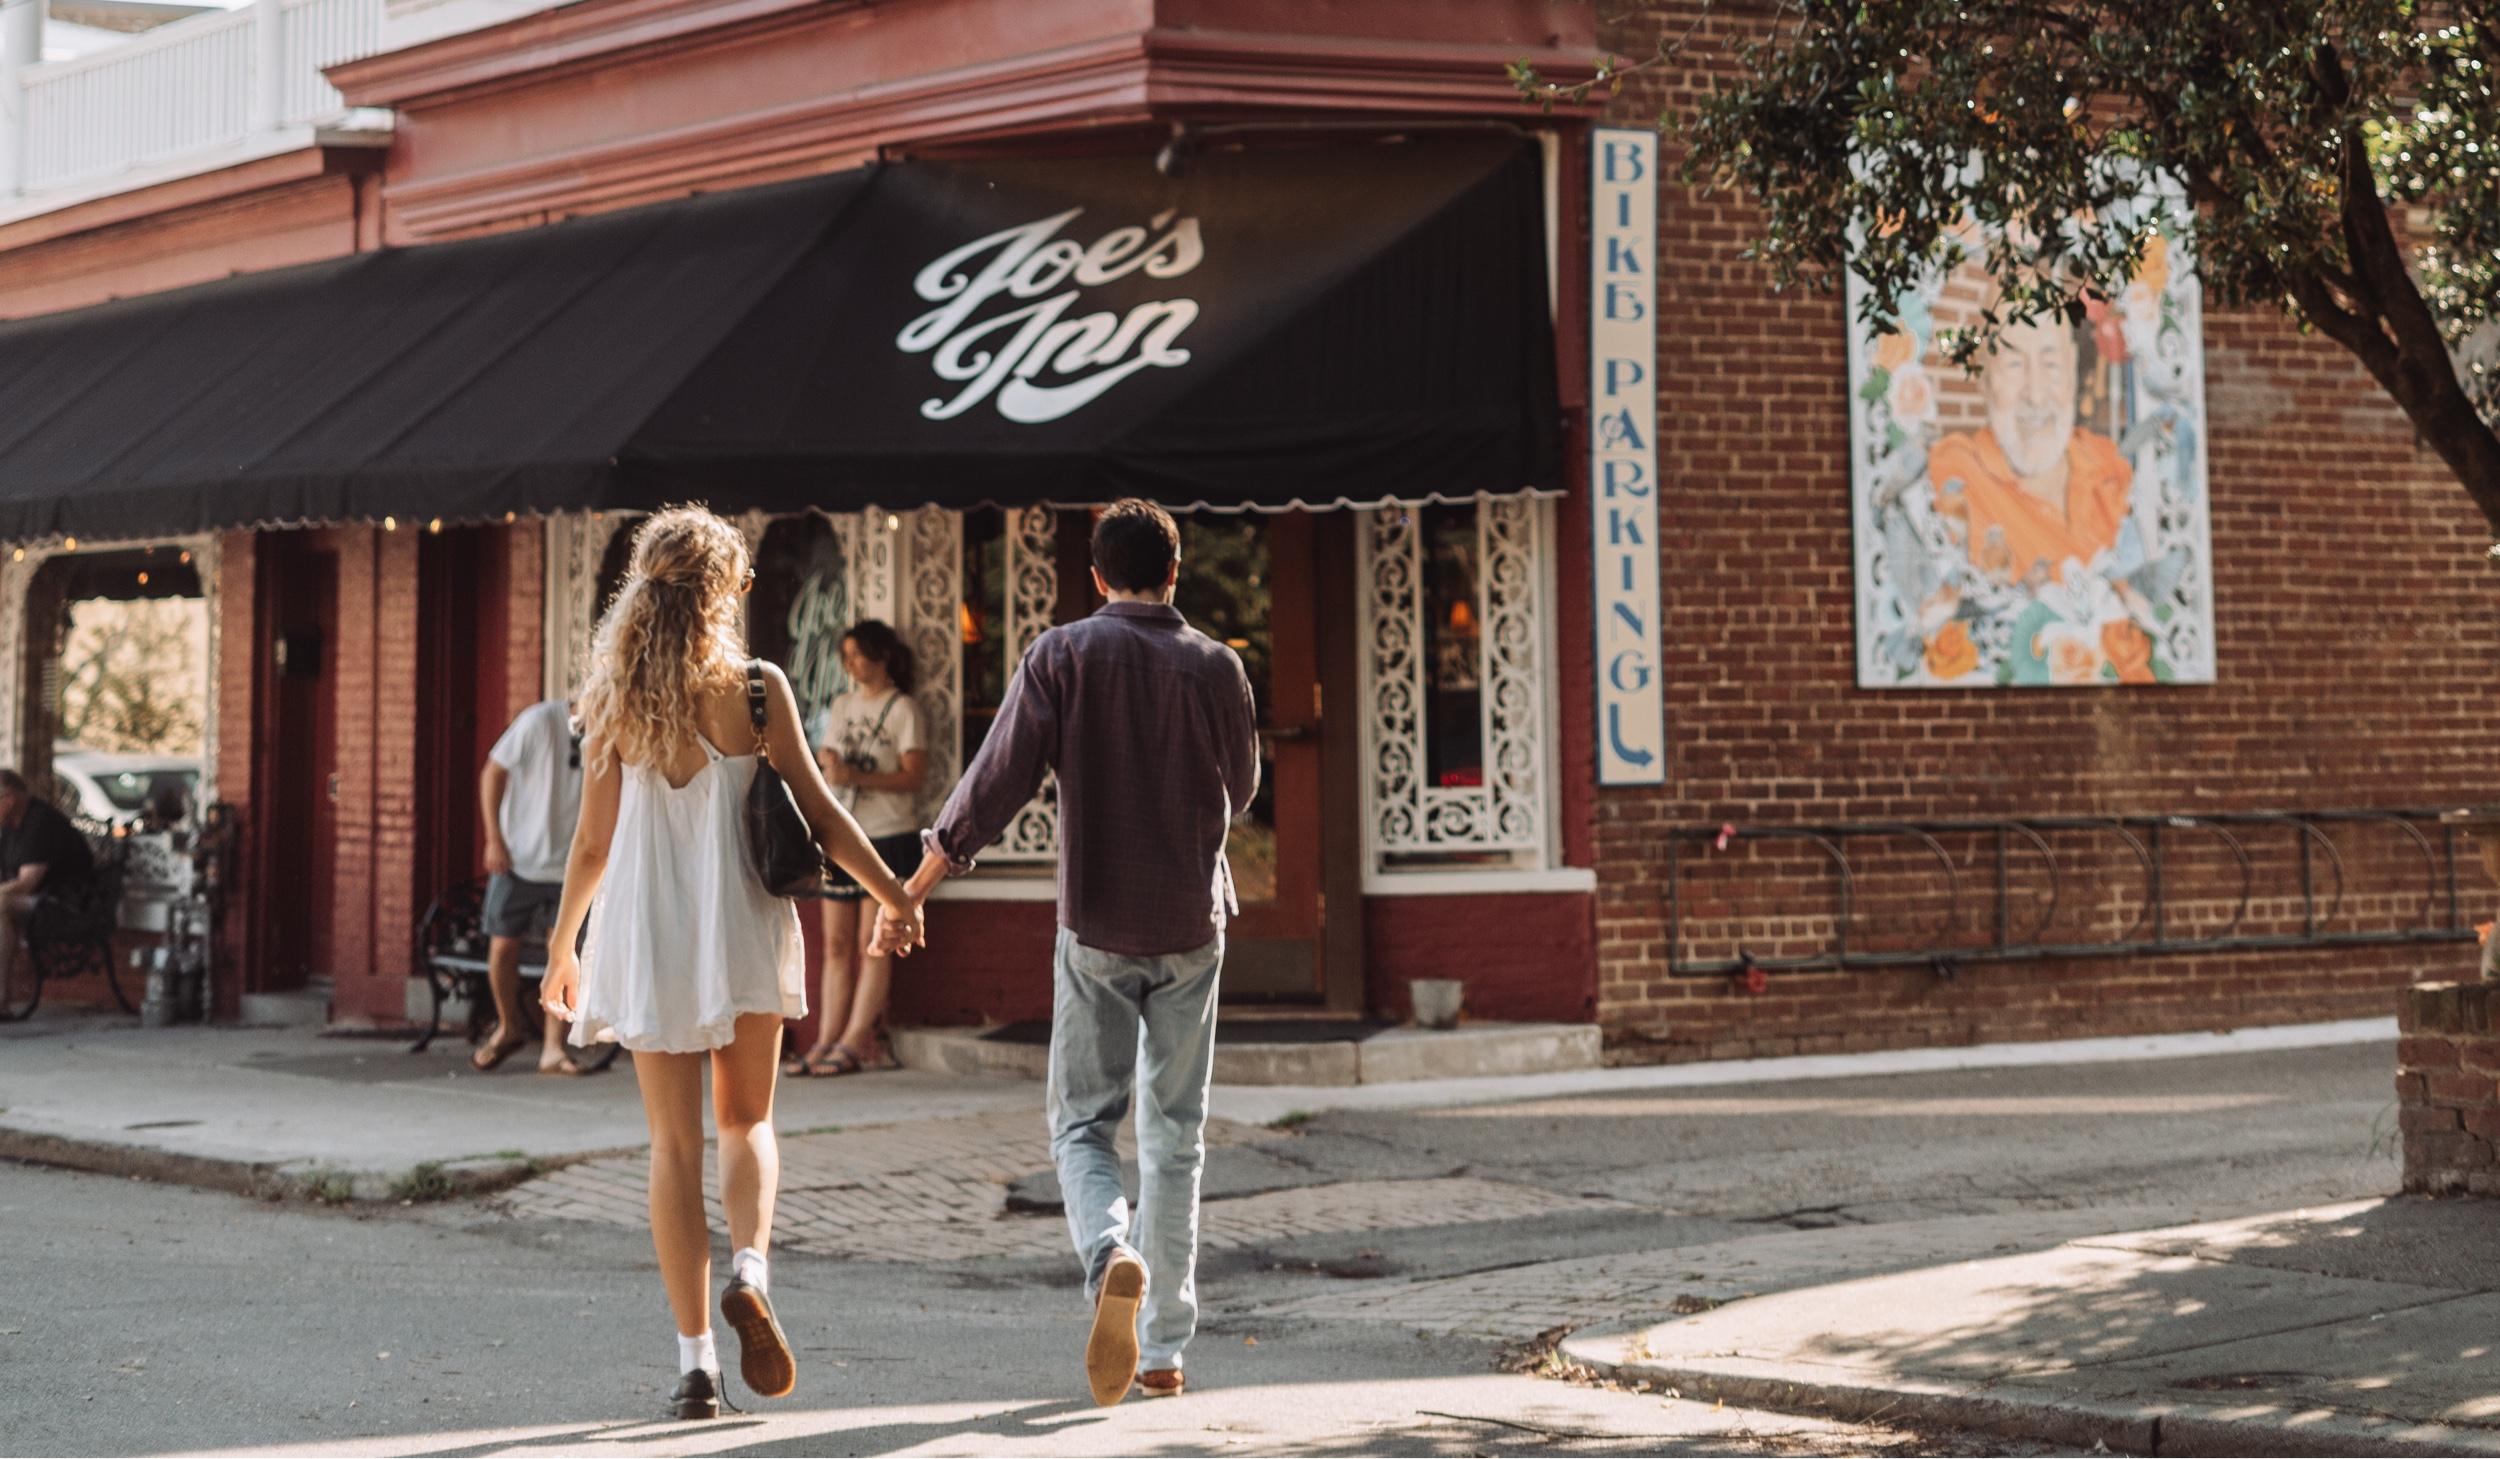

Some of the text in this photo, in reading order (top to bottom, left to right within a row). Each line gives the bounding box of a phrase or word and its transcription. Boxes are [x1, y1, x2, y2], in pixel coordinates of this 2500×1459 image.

[896, 206, 1204, 352] Joe's
[920, 290, 1199, 423] Inn
[1600, 141, 1654, 693] BIKE PARKING
